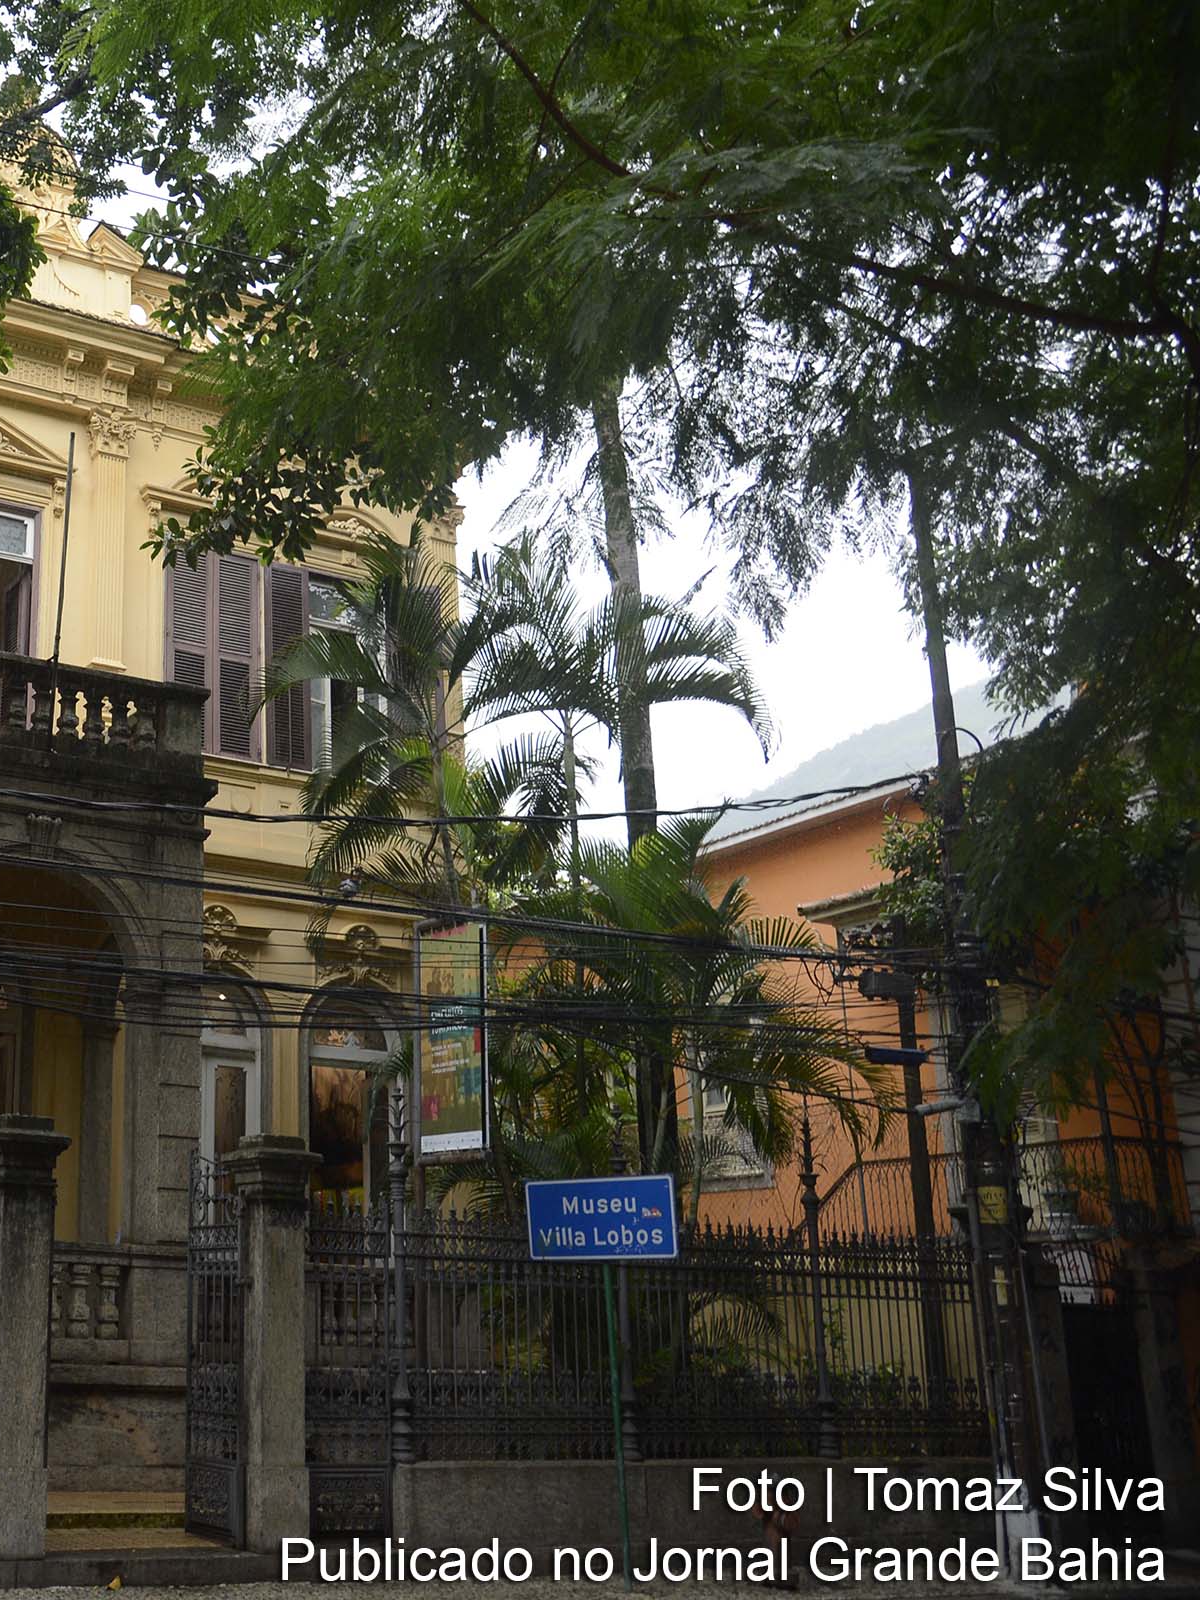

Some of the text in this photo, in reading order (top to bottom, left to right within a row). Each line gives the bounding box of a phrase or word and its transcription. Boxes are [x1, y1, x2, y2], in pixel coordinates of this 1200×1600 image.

[562, 1197, 637, 1215] Museu
[539, 1224, 664, 1247] Villa Lobos
